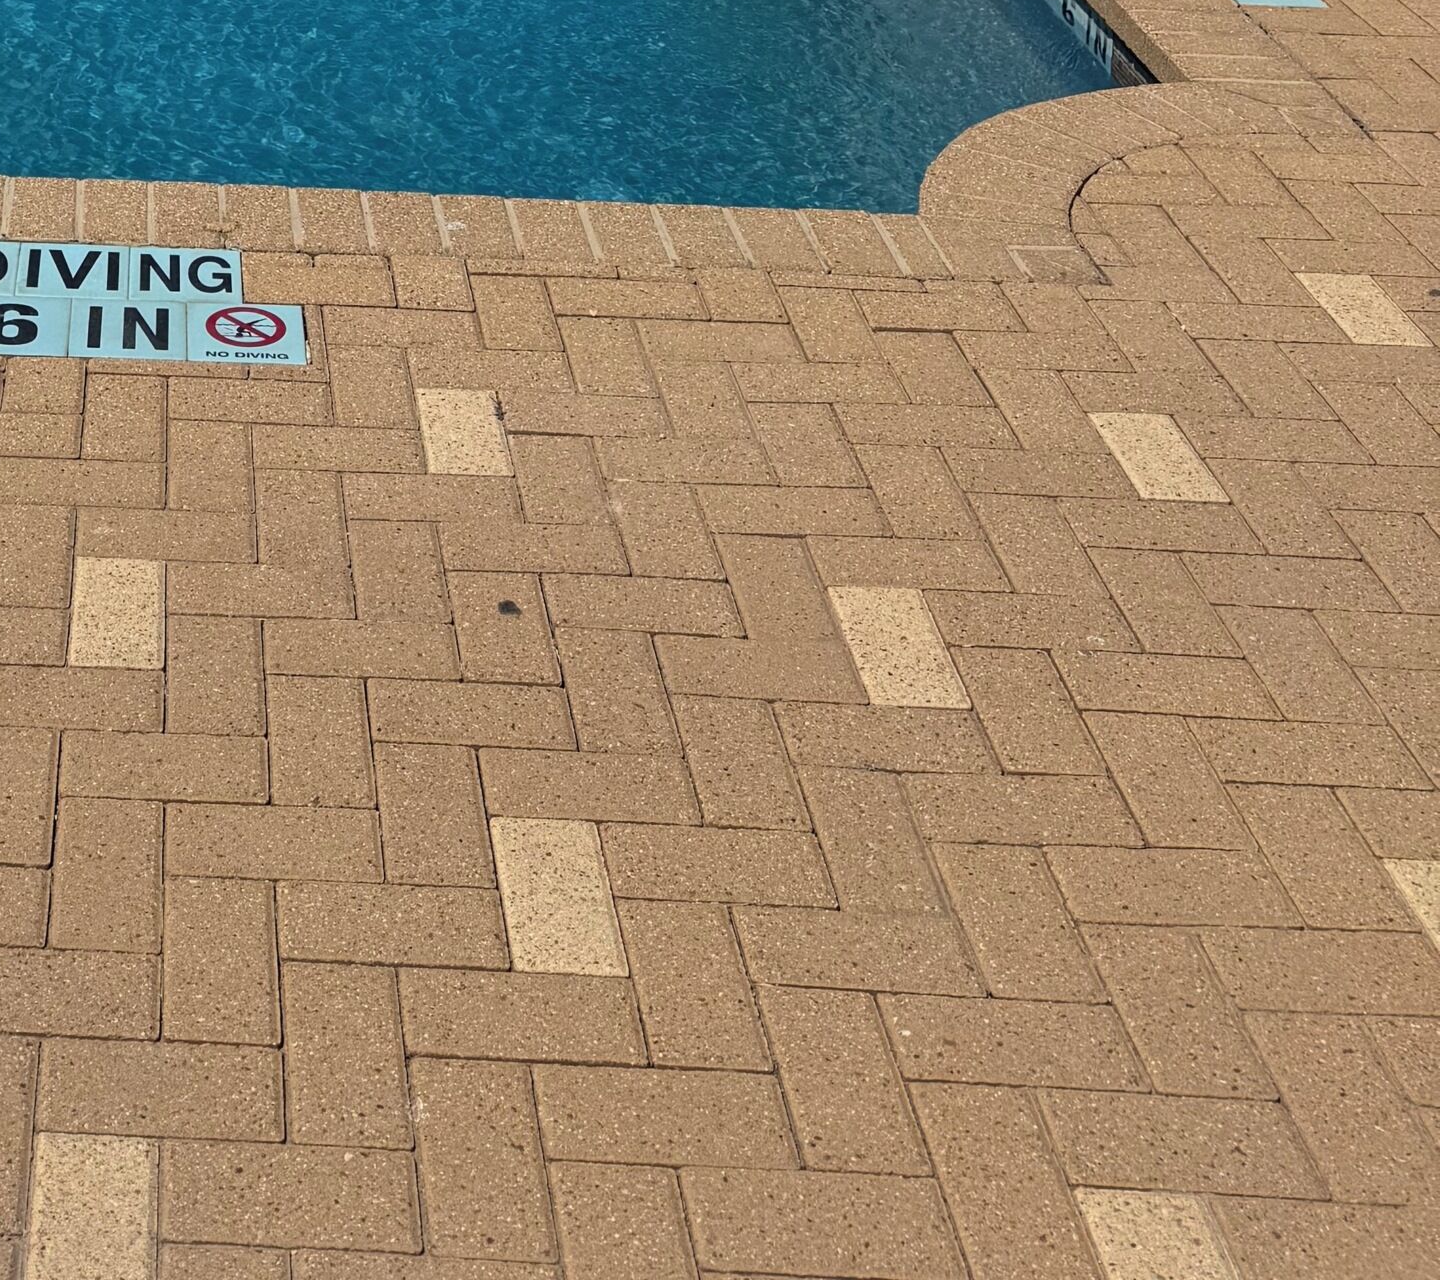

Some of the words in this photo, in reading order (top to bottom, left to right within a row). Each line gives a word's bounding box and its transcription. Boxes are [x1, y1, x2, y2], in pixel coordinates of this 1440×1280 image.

[1086, 18, 1107, 65] IN
[86, 304, 170, 351] IN
[234, 351, 290, 360] DIVING
